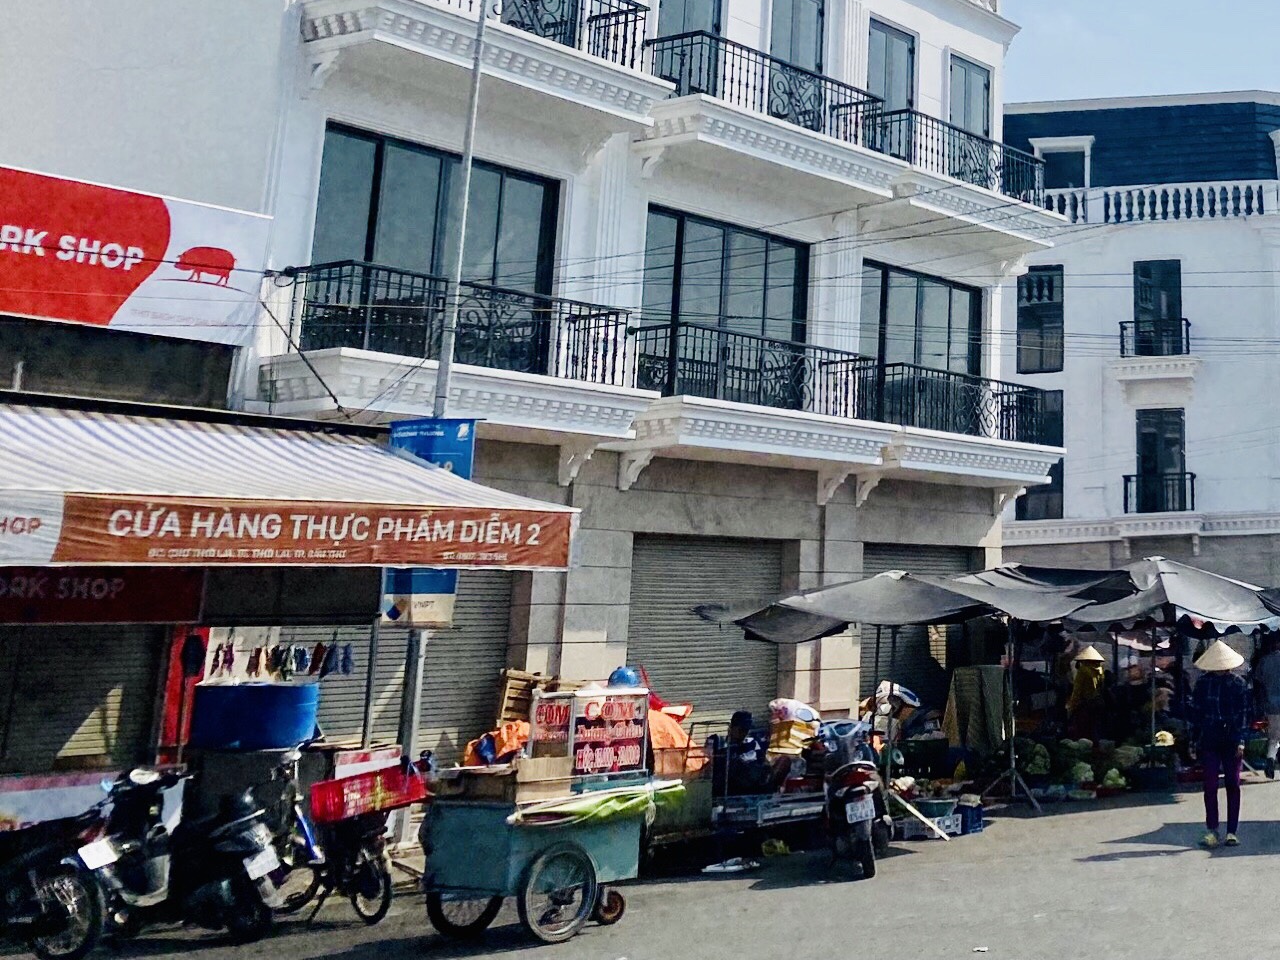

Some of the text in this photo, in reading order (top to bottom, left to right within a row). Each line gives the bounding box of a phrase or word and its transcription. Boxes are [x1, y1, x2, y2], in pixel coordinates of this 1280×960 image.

[56, 235, 145, 271] SHOP
[107, 502, 542, 547] CỬA HÀNG THỰC PHẨM DIỄM 2
[57, 577, 125, 600] SHOP
